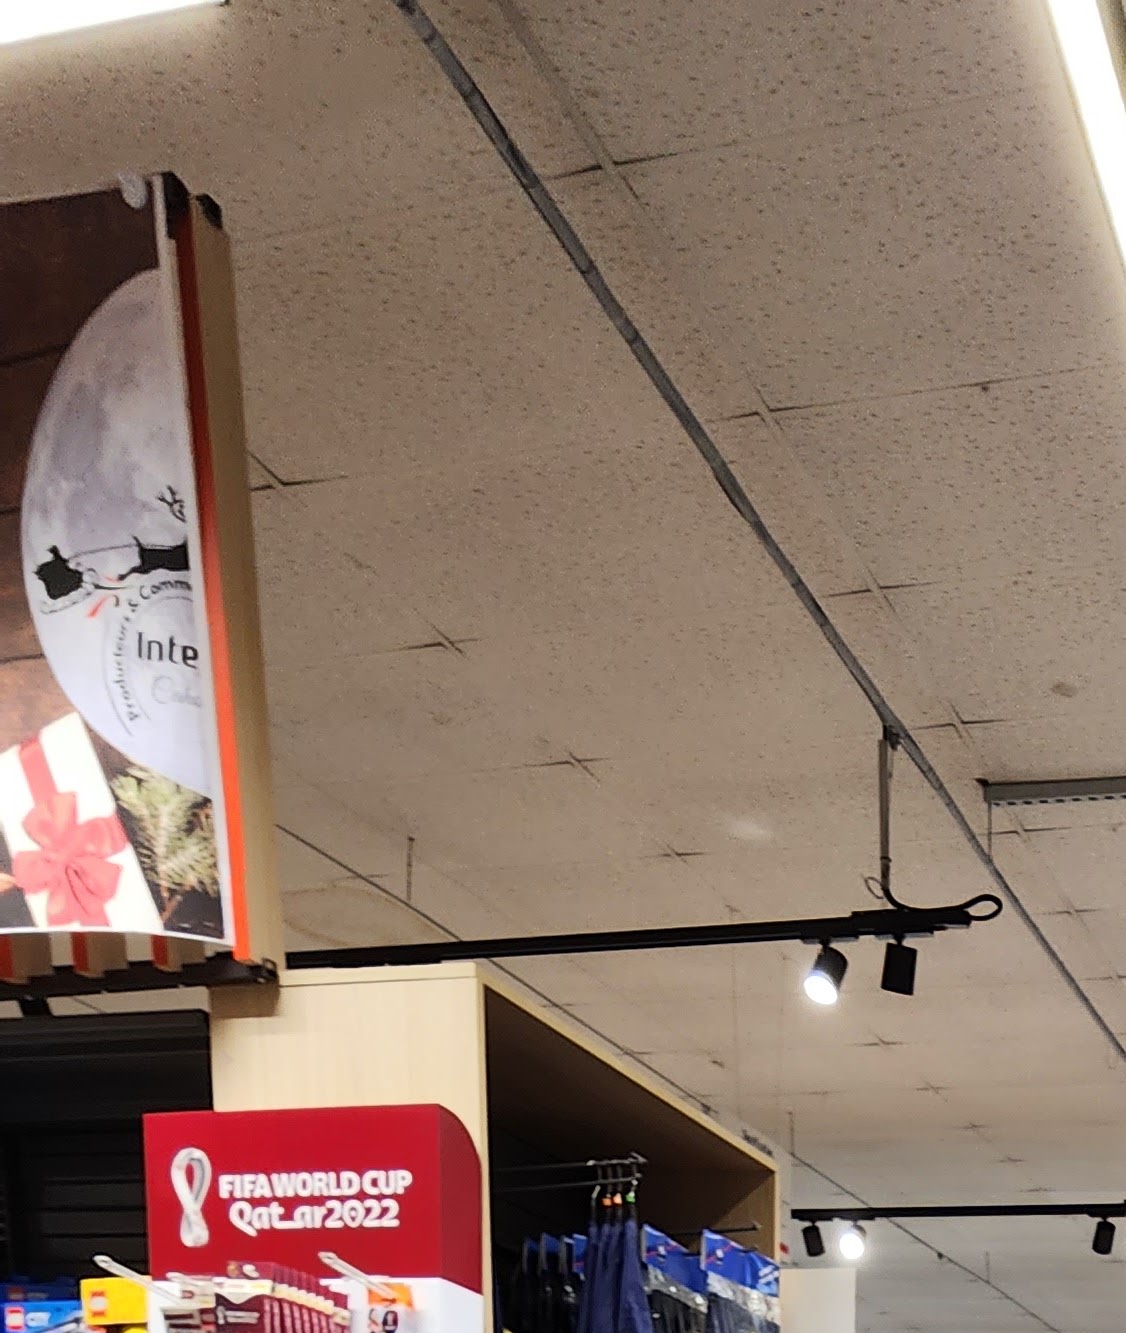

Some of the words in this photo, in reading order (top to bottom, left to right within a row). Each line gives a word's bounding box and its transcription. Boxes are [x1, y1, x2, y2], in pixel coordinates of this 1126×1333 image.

[137, 630, 199, 670] Inte
[218, 1173, 271, 1199] FIFA
[271, 1171, 360, 1198] WORLD
[362, 1169, 413, 1195] CUP
